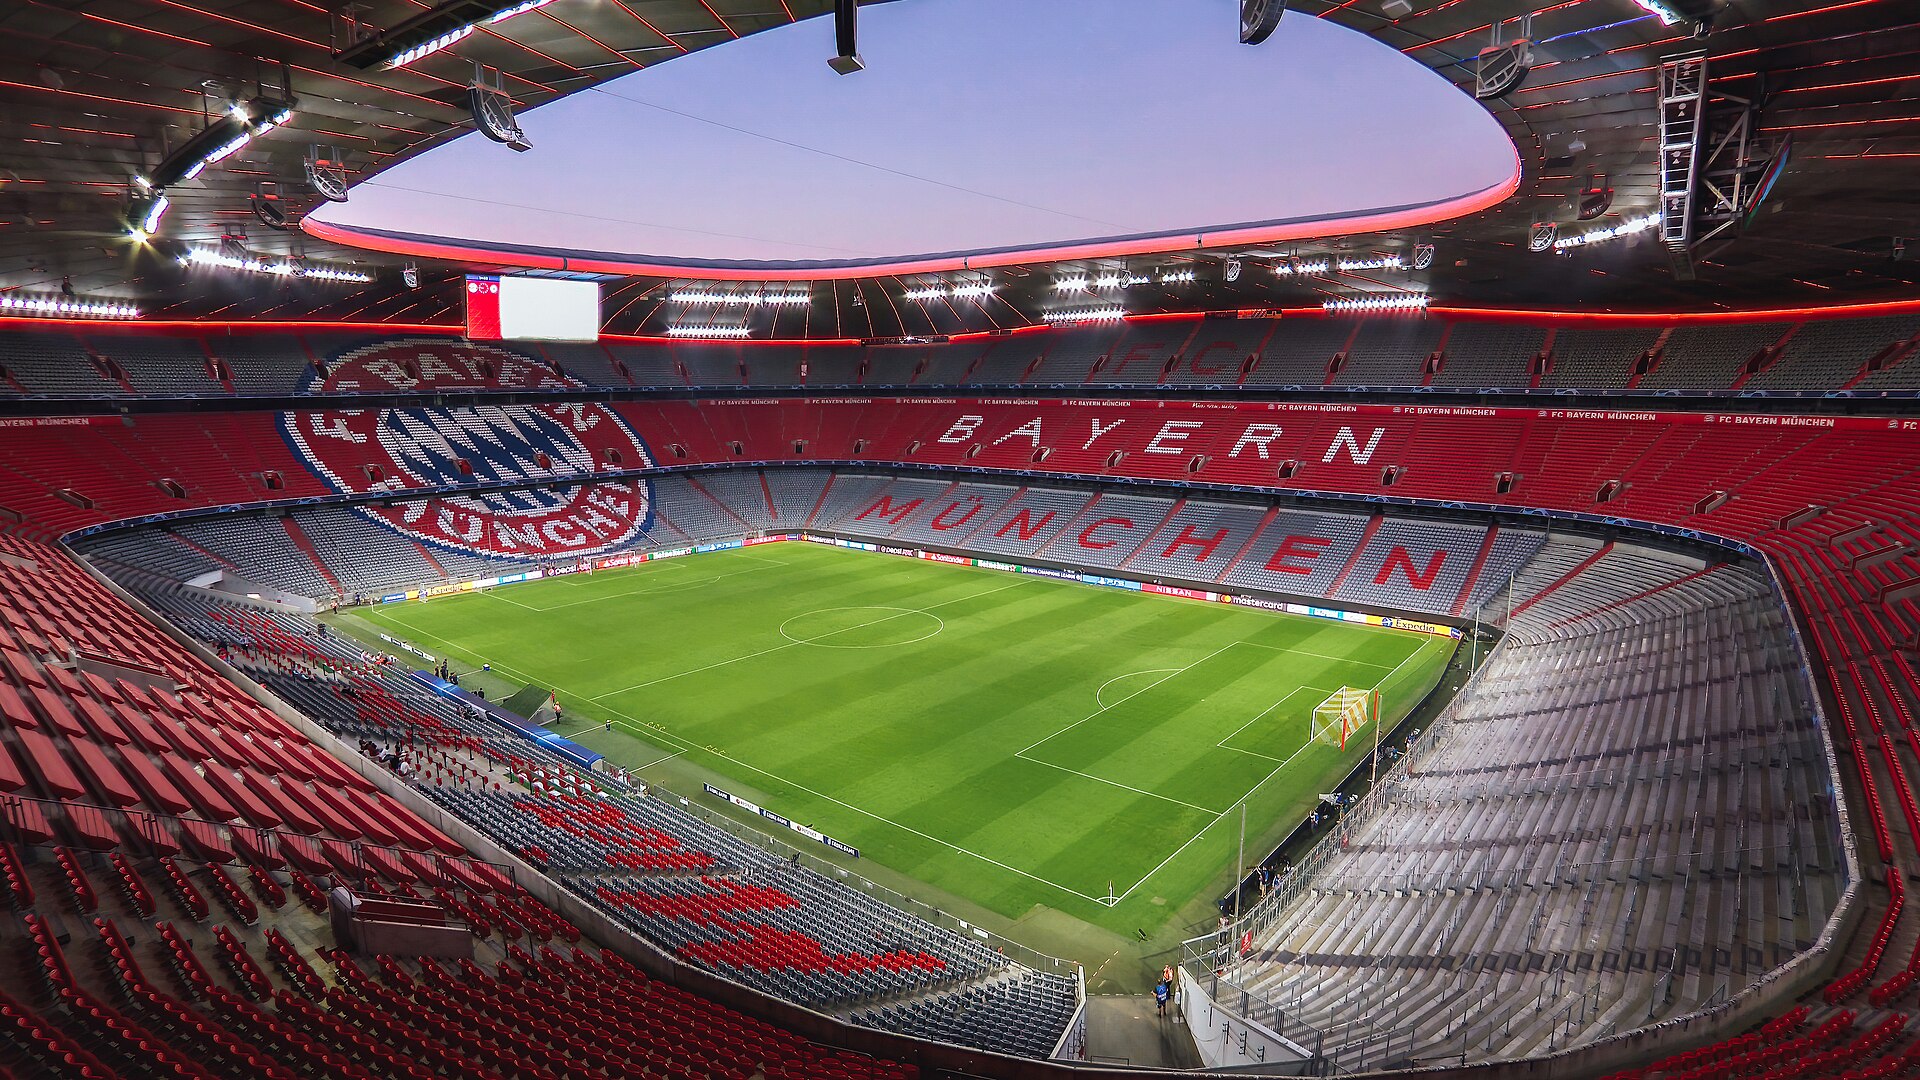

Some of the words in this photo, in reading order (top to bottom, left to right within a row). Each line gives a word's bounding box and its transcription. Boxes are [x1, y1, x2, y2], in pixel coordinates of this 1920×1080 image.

[1417, 407, 1451, 415] BAYERN
[1452, 406, 1496, 416] MÜNCHEN
[1566, 411, 1604, 419] BAYERN
[1607, 410, 1656, 421] MÜNCHEN
[36, 416, 90, 426] MÜNCHEN
[1735, 416, 1778, 425] BAYERN
[1781, 415, 1835, 427] MÜNCHEN
[1903, 421, 1918, 430] FC
[938, 415, 1386, 465] BAYERN
[854, 495, 1448, 591] MÜNCHEN
[936, 554, 965, 565] Santander
[555, 564, 577, 576] pepsi
[1156, 586, 1192, 597] NISSAN
[1233, 596, 1283, 610] mastercard
[1395, 618, 1435, 633] Expedia
